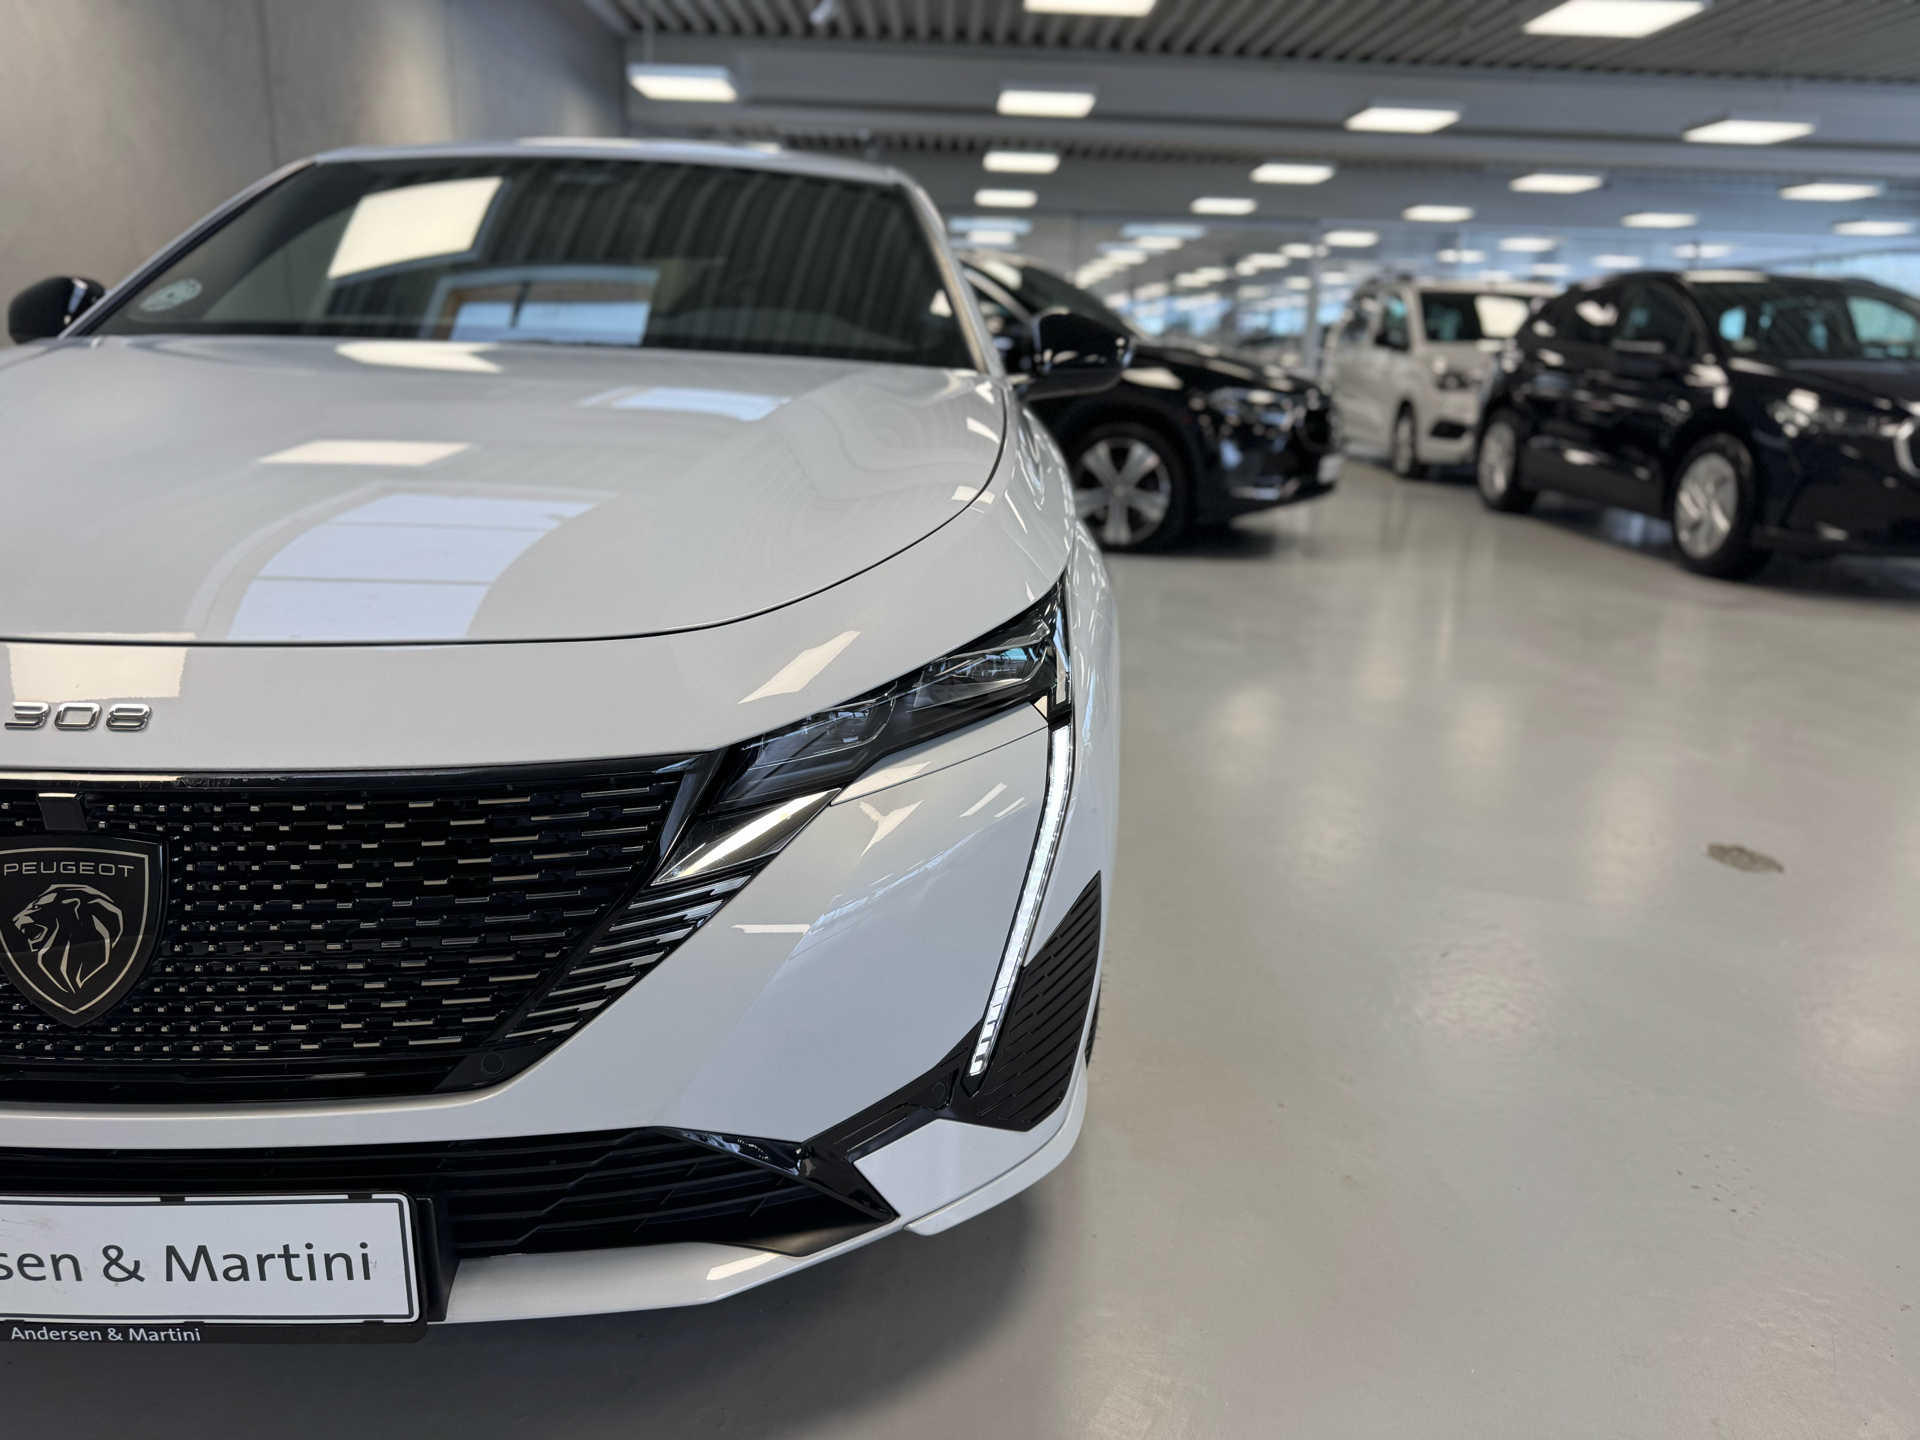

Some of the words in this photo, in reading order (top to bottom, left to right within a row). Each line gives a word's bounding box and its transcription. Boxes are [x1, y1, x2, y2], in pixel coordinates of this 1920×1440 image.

[5, 702, 152, 730] 308
[4, 861, 134, 877] PEUGEOT
[102, 1244, 146, 1283] &
[165, 1242, 371, 1282] Martini
[11, 1326, 102, 1341] Andersen
[108, 1327, 123, 1341] &
[129, 1328, 201, 1342] Martini
